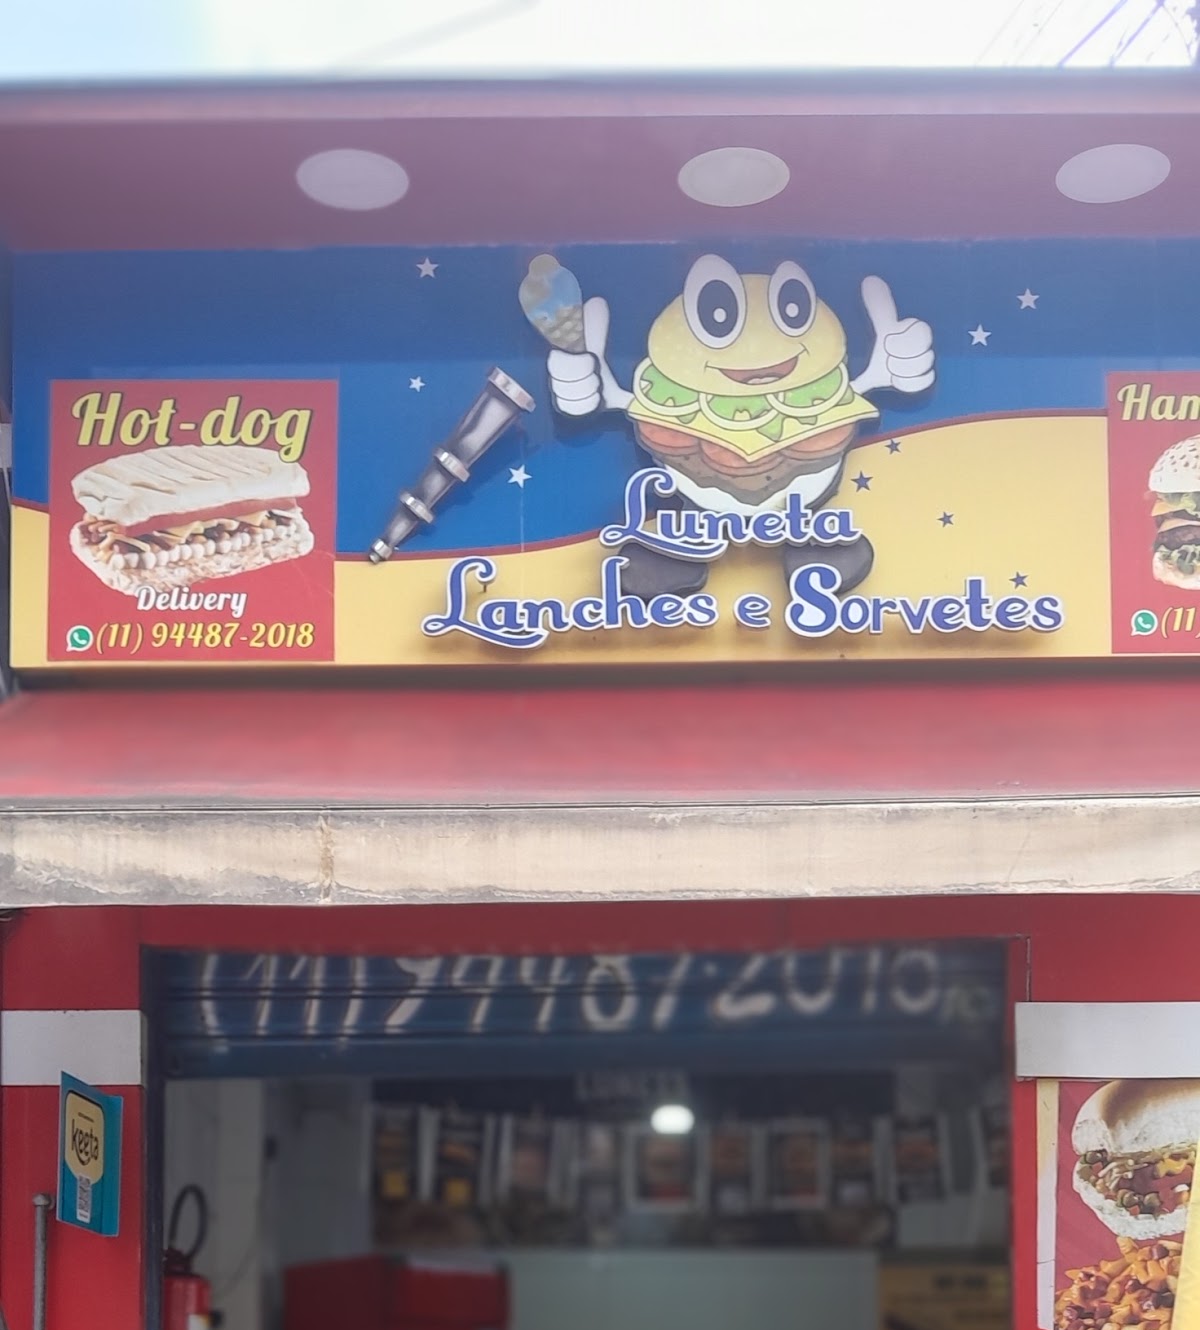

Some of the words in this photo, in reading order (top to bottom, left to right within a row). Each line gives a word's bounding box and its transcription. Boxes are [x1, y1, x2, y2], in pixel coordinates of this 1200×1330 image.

[71, 391, 312, 462] Hot-dog
[600, 467, 860, 560] Luneta
[137, 586, 247, 618] Delivery
[421, 556, 718, 649] Lanches
[733, 592, 771, 630] e
[784, 563, 1064, 638] Sorvetes
[1161, 606, 1200, 639] (11
[96, 622, 143, 655] (11)
[151, 622, 315, 649] 94487-2018
[71, 1118, 99, 1162] keeta
